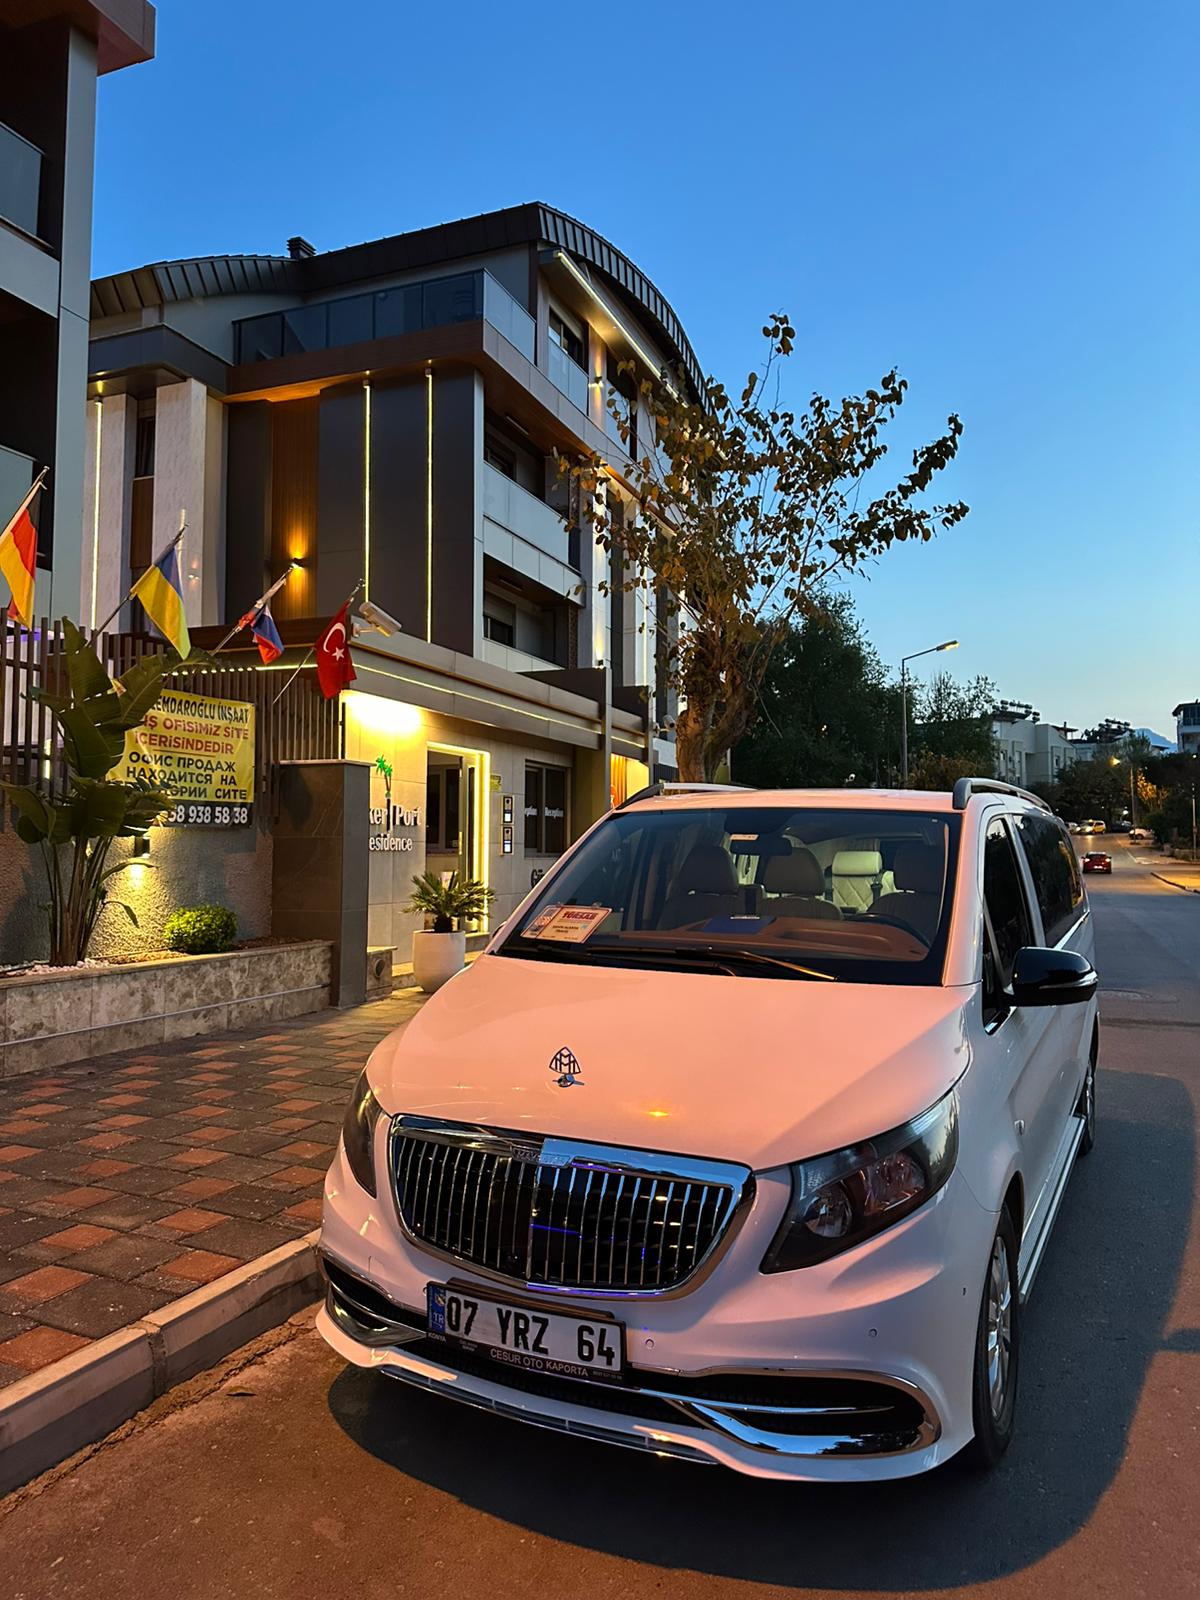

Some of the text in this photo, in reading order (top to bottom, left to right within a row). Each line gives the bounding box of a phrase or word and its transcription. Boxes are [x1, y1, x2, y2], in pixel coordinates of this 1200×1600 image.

[163, 718, 221, 737] OFİSİMİZ
[223, 726, 249, 740] SİTE
[177, 757, 236, 773] ПРОДАЖ
[126, 766, 237, 786] НАХОДИТСЯ НА
[215, 788, 247, 800] СИТЕ
[188, 805, 212, 823] 938
[214, 806, 230, 823] 58
[233, 807, 248, 824] 38
[396, 805, 422, 826] Port
[369, 833, 413, 851] esidence
[433, 1312, 444, 1324] TR
[446, 1295, 615, 1367] 07 YRZ 64
[490, 1348, 521, 1364] CESUR
[523, 1356, 543, 1369] OTO
[545, 1360, 589, 1377] KAPORTA
